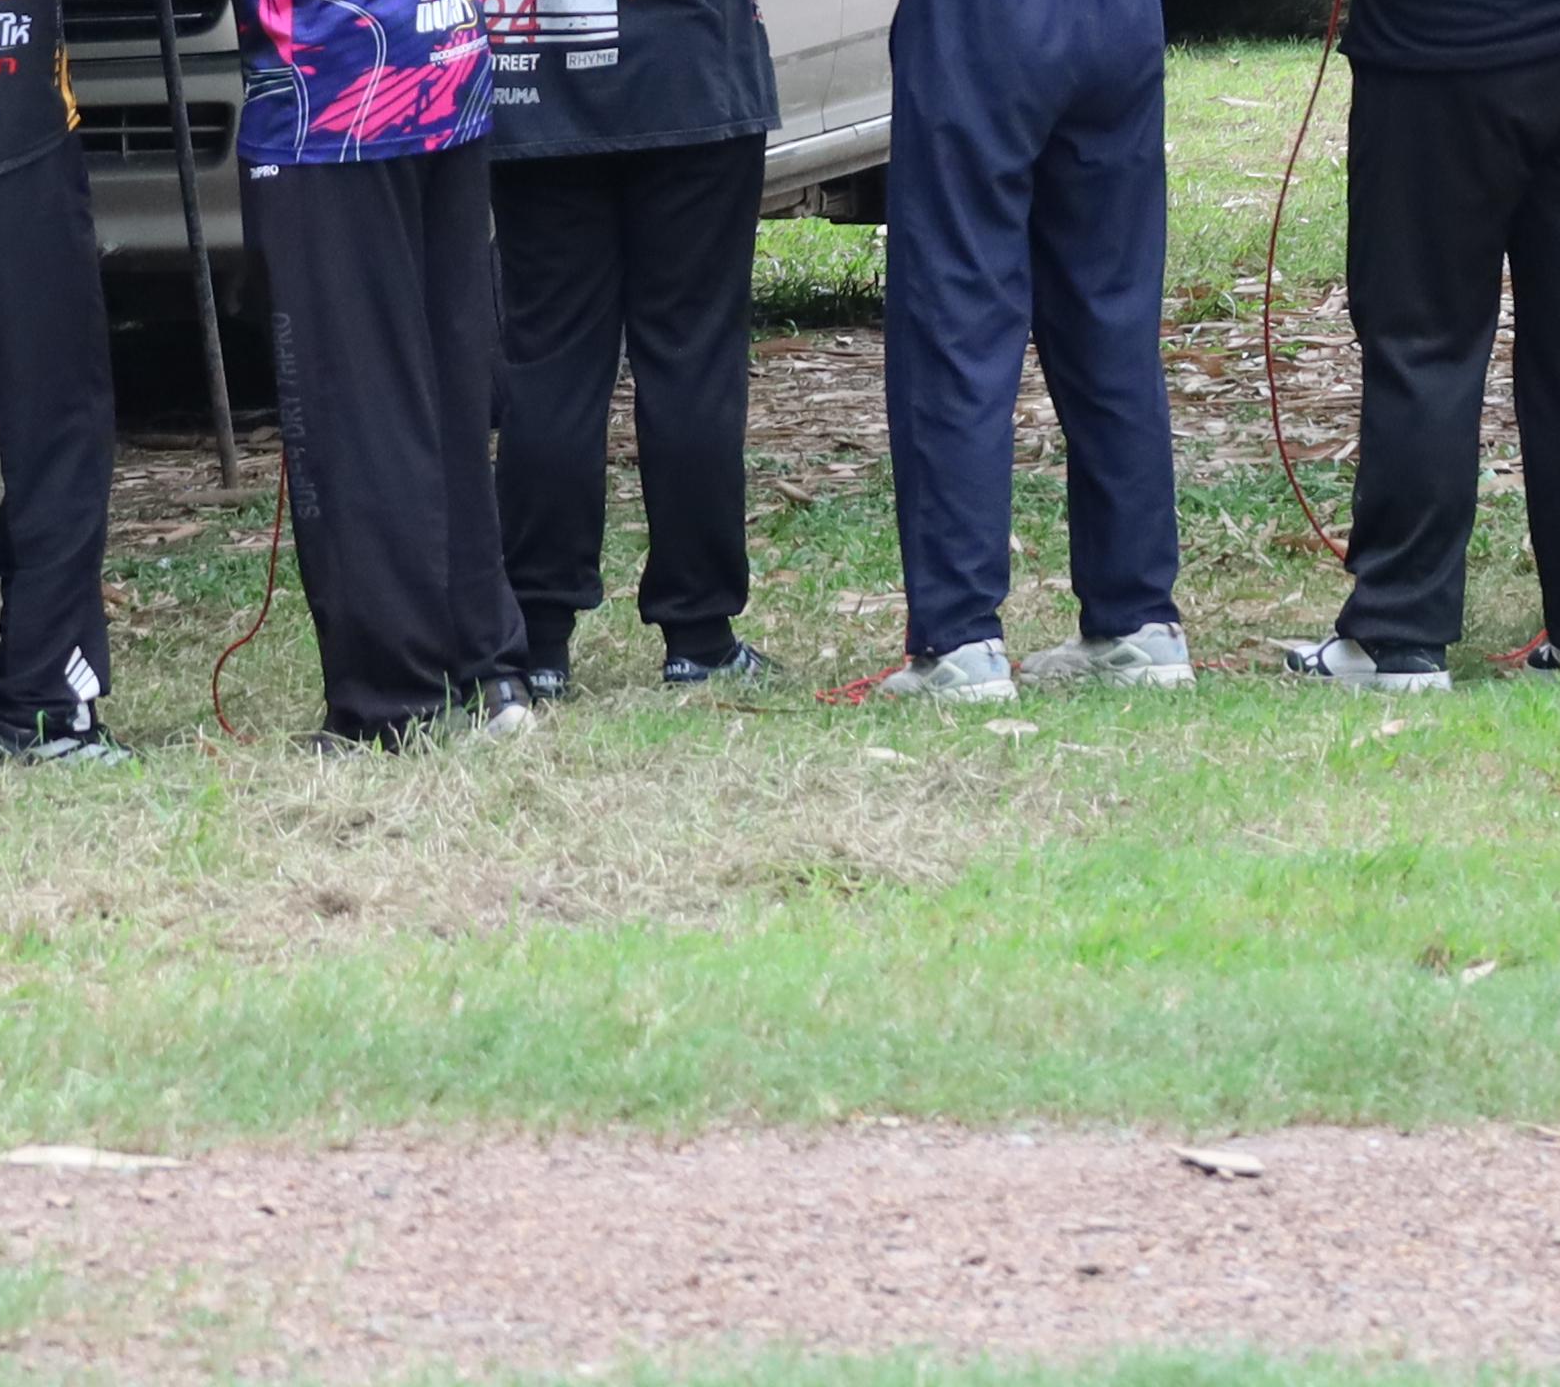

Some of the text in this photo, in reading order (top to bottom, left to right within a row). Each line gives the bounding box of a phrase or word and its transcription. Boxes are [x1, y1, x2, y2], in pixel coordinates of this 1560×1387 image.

[490, 50, 616, 71] TREET RHYME
[491, 87, 541, 104] RUMA
